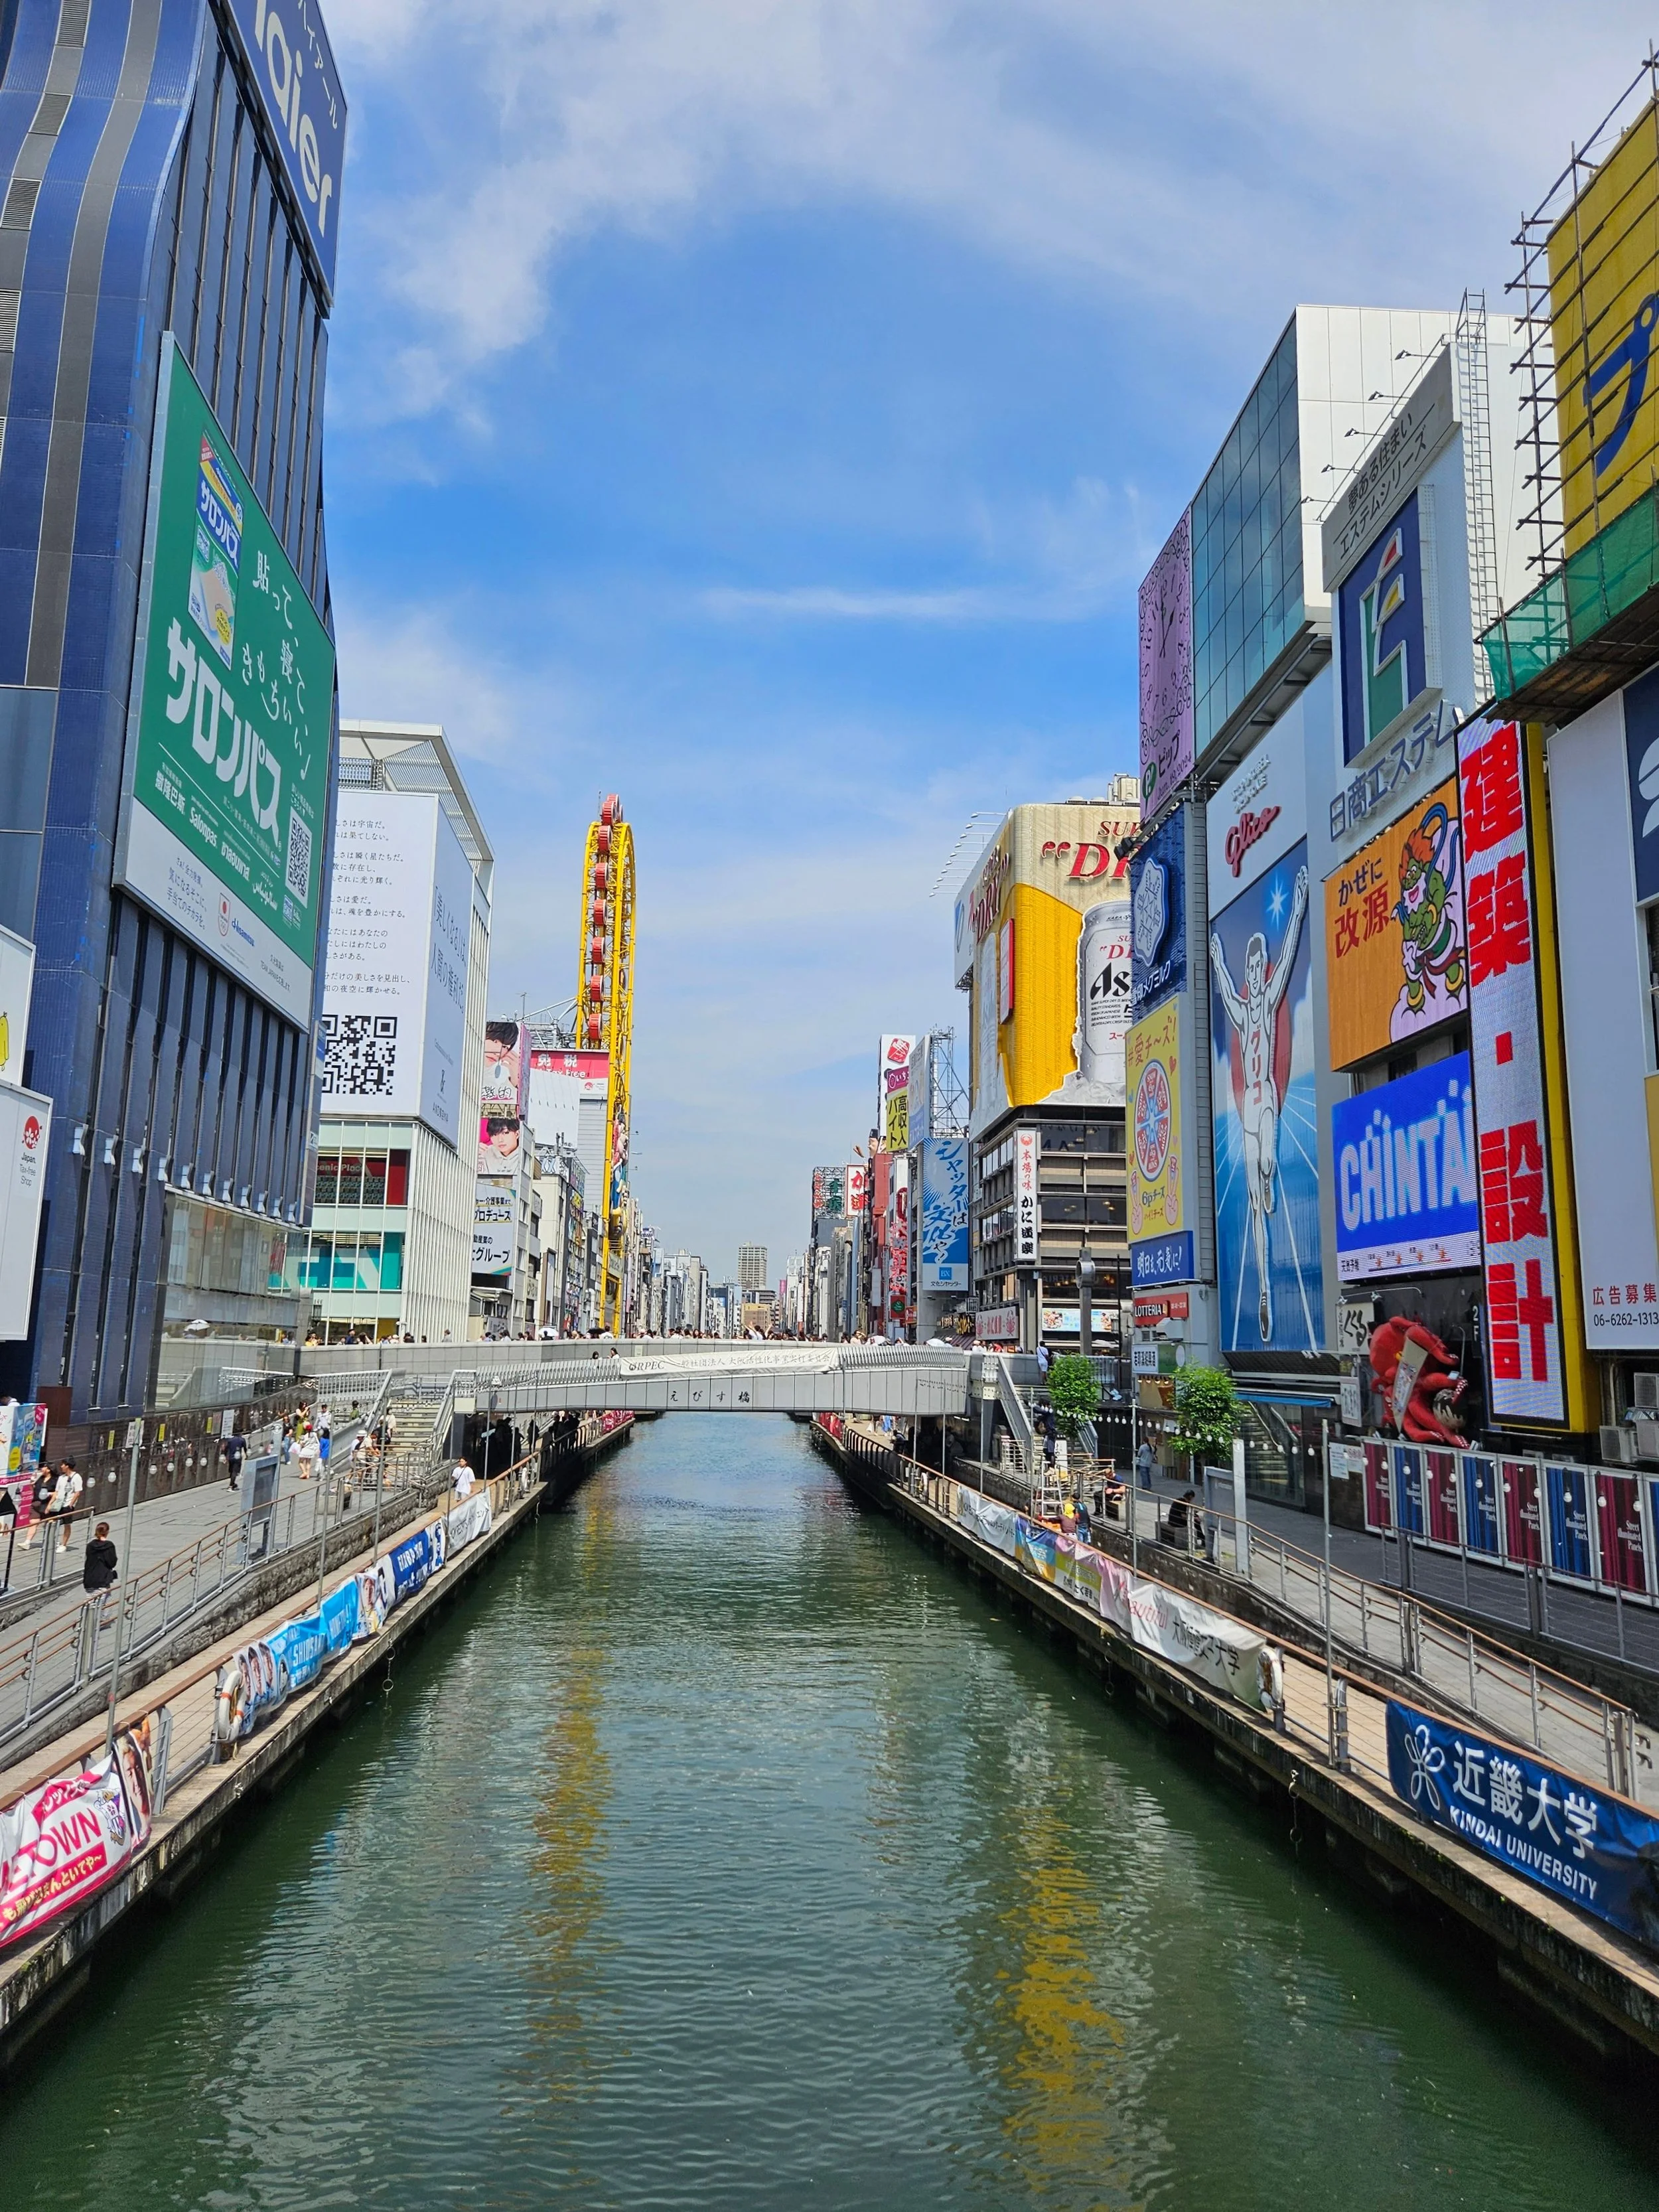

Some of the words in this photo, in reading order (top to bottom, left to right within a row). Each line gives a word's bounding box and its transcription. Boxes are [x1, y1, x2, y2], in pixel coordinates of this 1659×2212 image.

[1339, 425, 1428, 561] エステムシリーズ
[1346, 412, 1413, 515] 夢ある住まい
[252, 550, 299, 647] 貼って、
[242, 642, 302, 756] きもちいい
[280, 639, 308, 736] 寝て、
[165, 617, 282, 848] サロンパス
[189, 806, 218, 849] Salonpas
[1225, 805, 1281, 877] Glico
[1338, 855, 1384, 907] かぜに
[1333, 880, 1390, 959] 改源
[1250, 1024, 1262, 1107] グリコ
[889, 1098, 897, 1149] バイト
[898, 1095, 908, 1148] 高収入
[1020, 1195, 1033, 1254] かに道楽
[1135, 1305, 1161, 1317] LOTTERIA
[1593, 1283, 1657, 1305] 広告募集
[1593, 1312, 1659, 1327] 06-6262-1313
[670, 1390, 750, 1402] えびす橋
[1453, 1740, 1597, 1859] 近畿大学
[1449, 1805, 1502, 1848] KINDAI
[1506, 1836, 1597, 1900] UNIVERSITY
